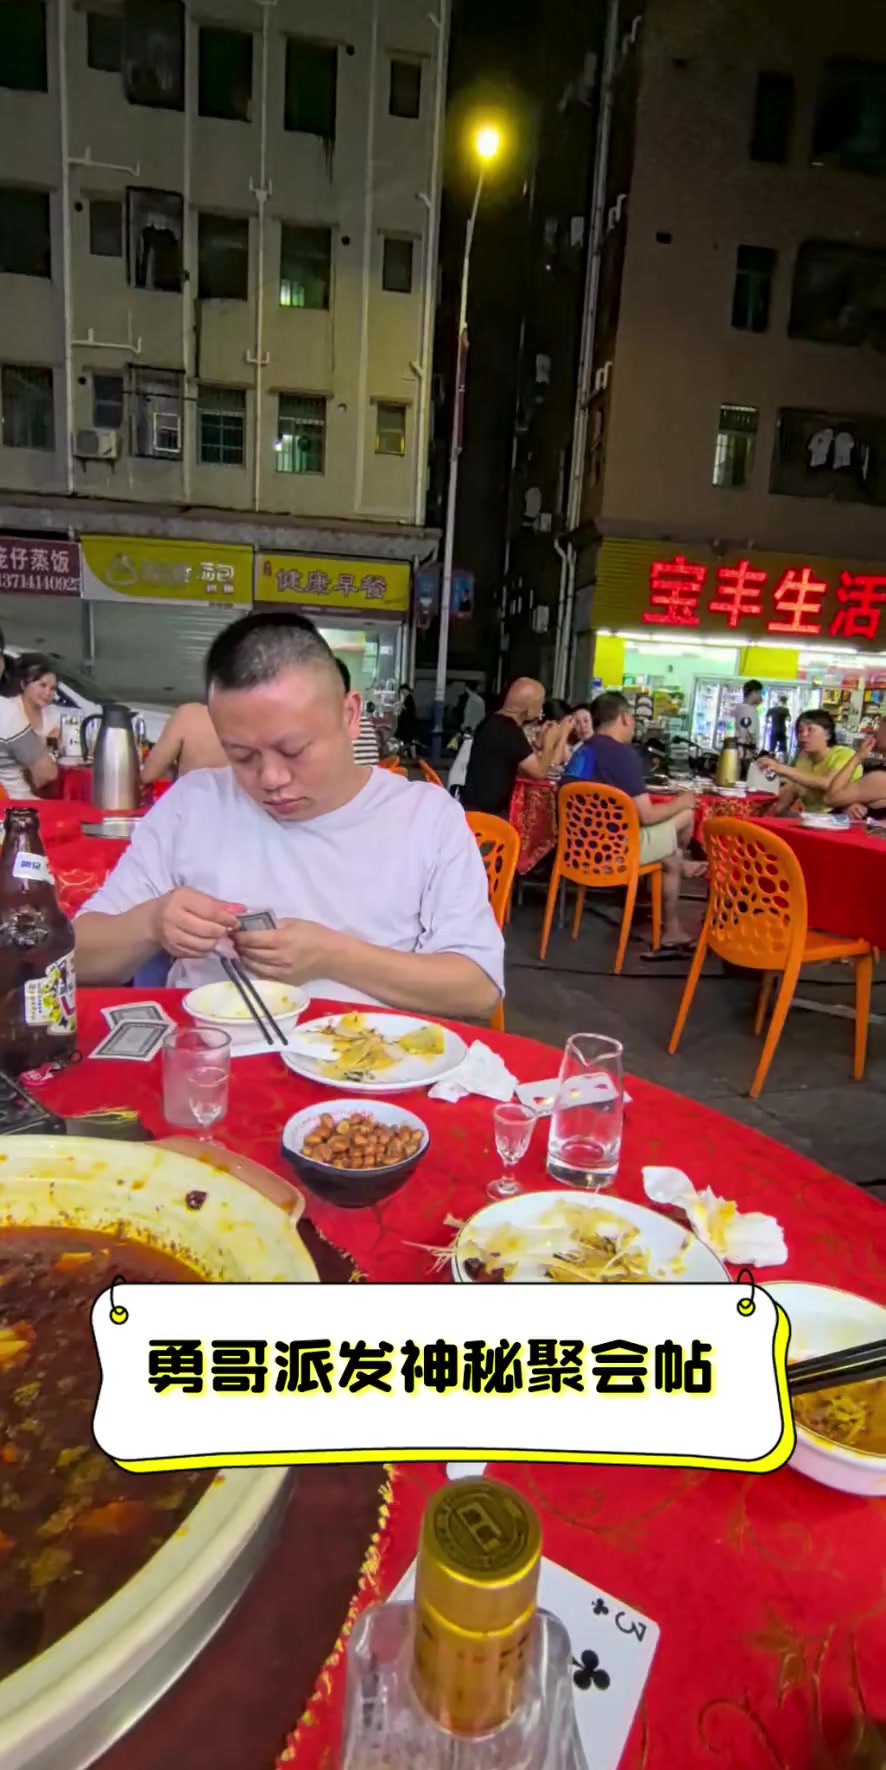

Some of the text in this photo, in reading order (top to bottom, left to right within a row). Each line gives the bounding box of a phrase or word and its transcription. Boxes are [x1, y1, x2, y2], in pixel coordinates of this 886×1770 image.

[276, 568, 387, 599] 健康早餐
[642, 555, 886, 640] 宝丰生活
[615, 1611, 647, 1642] 3
